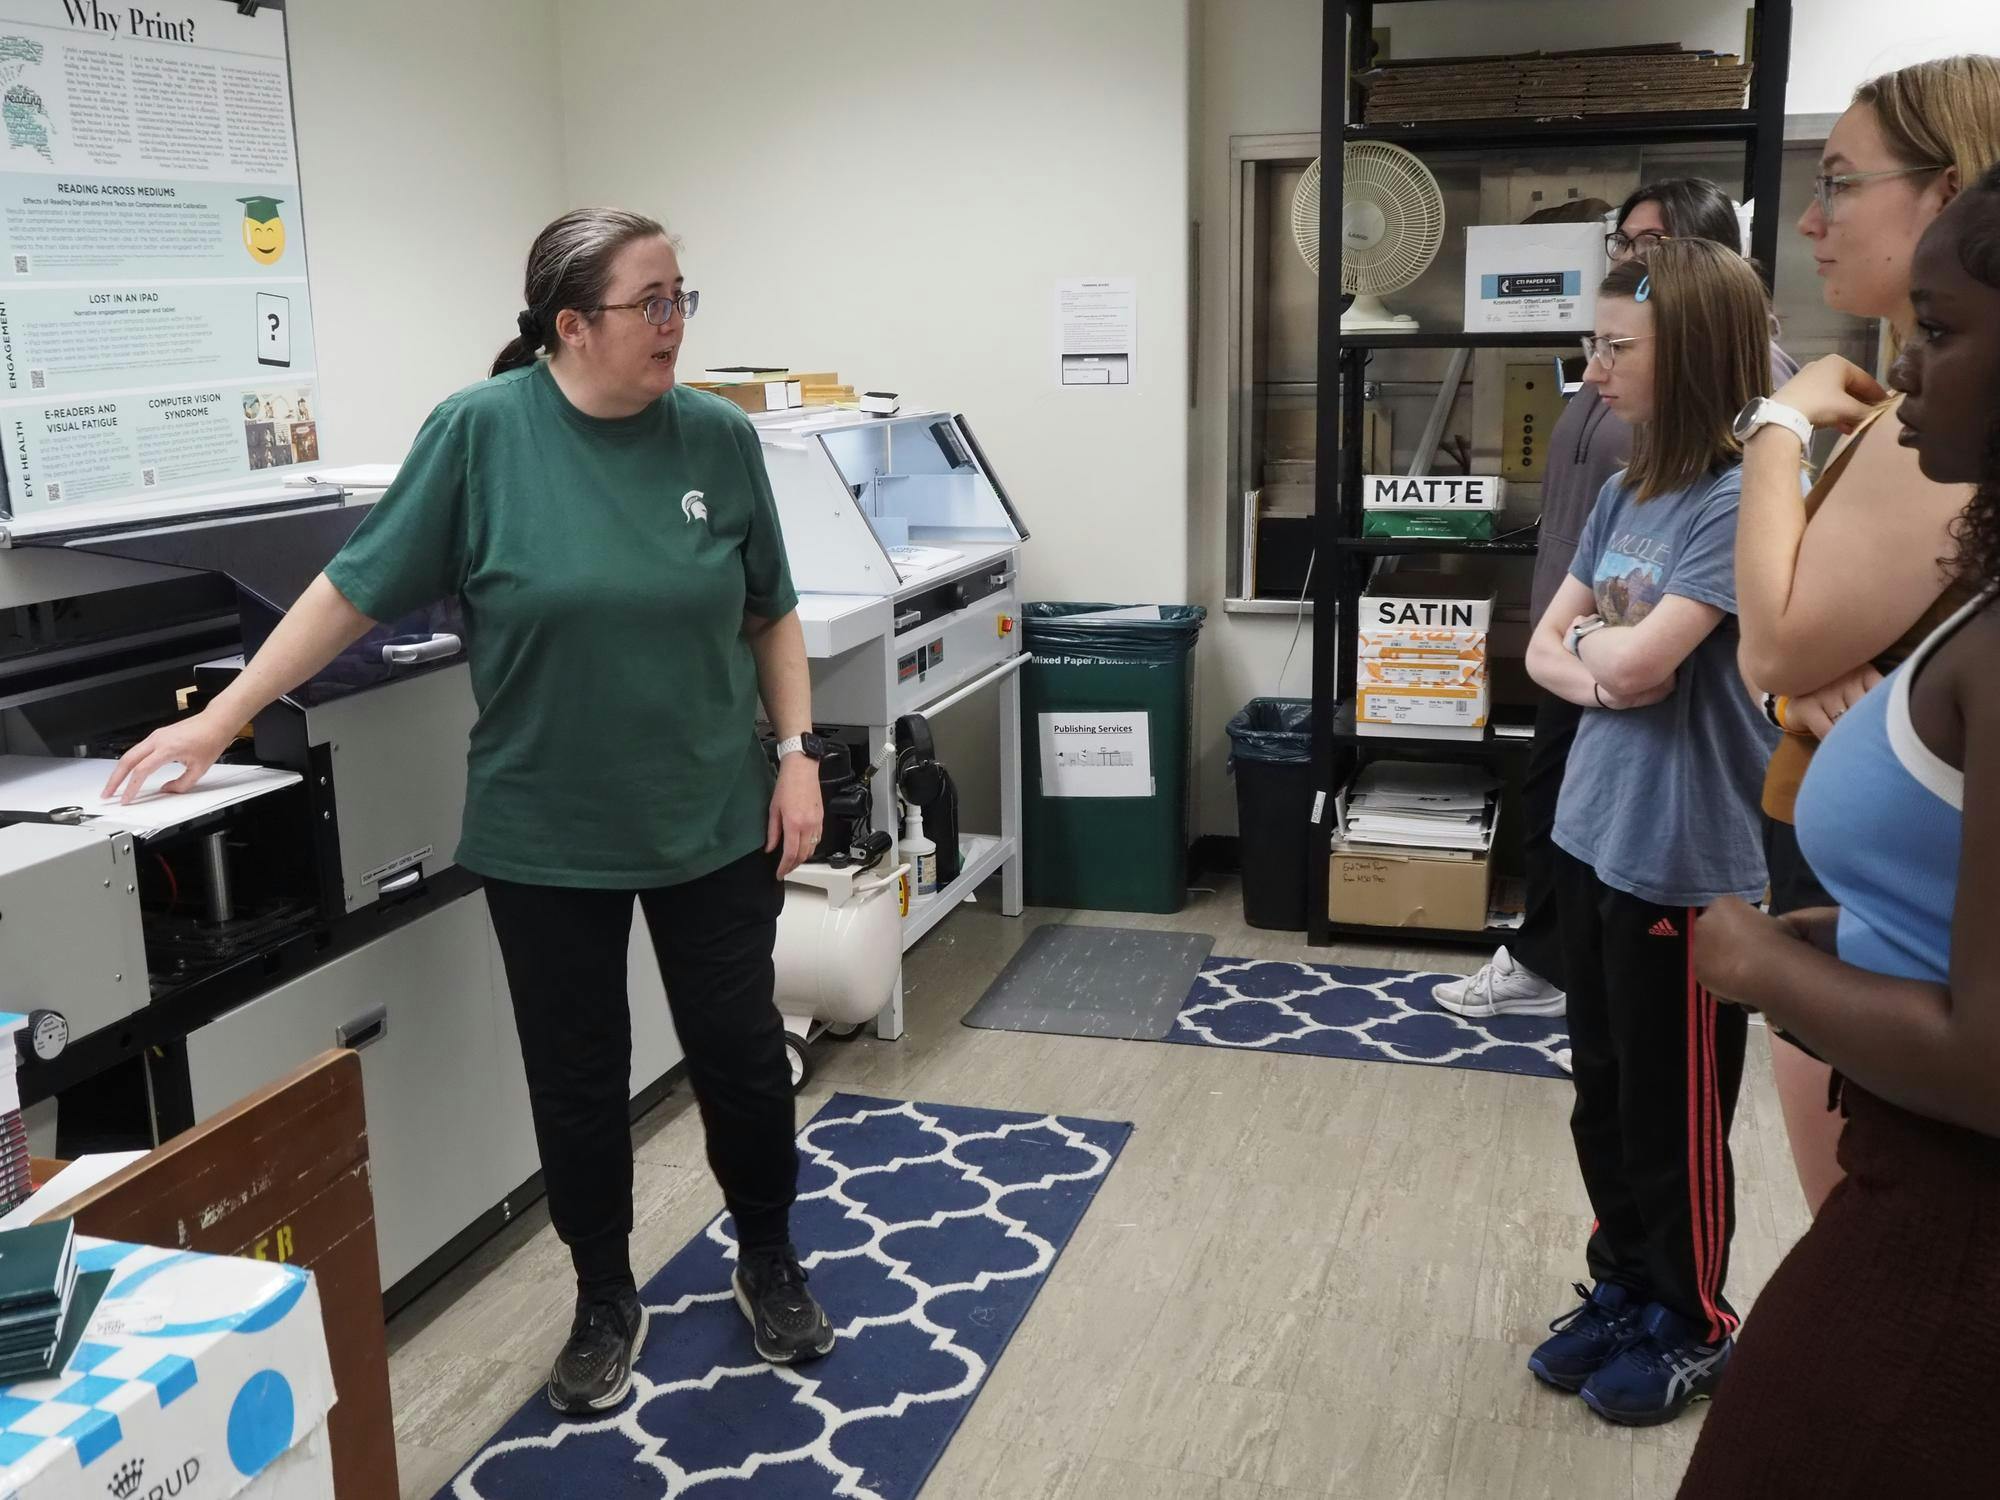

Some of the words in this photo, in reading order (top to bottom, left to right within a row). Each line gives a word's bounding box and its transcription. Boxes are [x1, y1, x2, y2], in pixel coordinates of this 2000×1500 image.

[61, 0, 121, 41] Why
[128, 8, 195, 43] Print?
[4, 94, 42, 113] reading
[57, 183, 99, 194] READING
[101, 185, 136, 195] ACROSS
[137, 187, 176, 197] MEDIUMS
[89, 294, 110, 304] LOST
[113, 294, 122, 302] IN
[125, 293, 137, 302] AN
[139, 292, 159, 302] IPAD
[0, 301, 17, 389] ENGAGEMEN
[148, 395, 192, 408] COMPUTER
[194, 392, 221, 404] VISION
[44, 406, 96, 420] E-READERS
[98, 403, 117, 414] AND
[164, 406, 209, 420] SYNDROME
[47, 419, 80, 433] VISUAL
[82, 417, 118, 430] FATIGUE
[15, 421, 29, 470] HEALTH
[23, 473, 33, 498] EYE
[1375, 480, 1483, 503] MATTE
[1379, 602, 1472, 626] SATIN
[1031, 656, 1061, 665] Mixed
[1064, 656, 1092, 667] Paper
[1054, 725, 1096, 734] Publishing
[1098, 725, 1133, 733] Services
[138, 1457, 200, 1500] RUD
